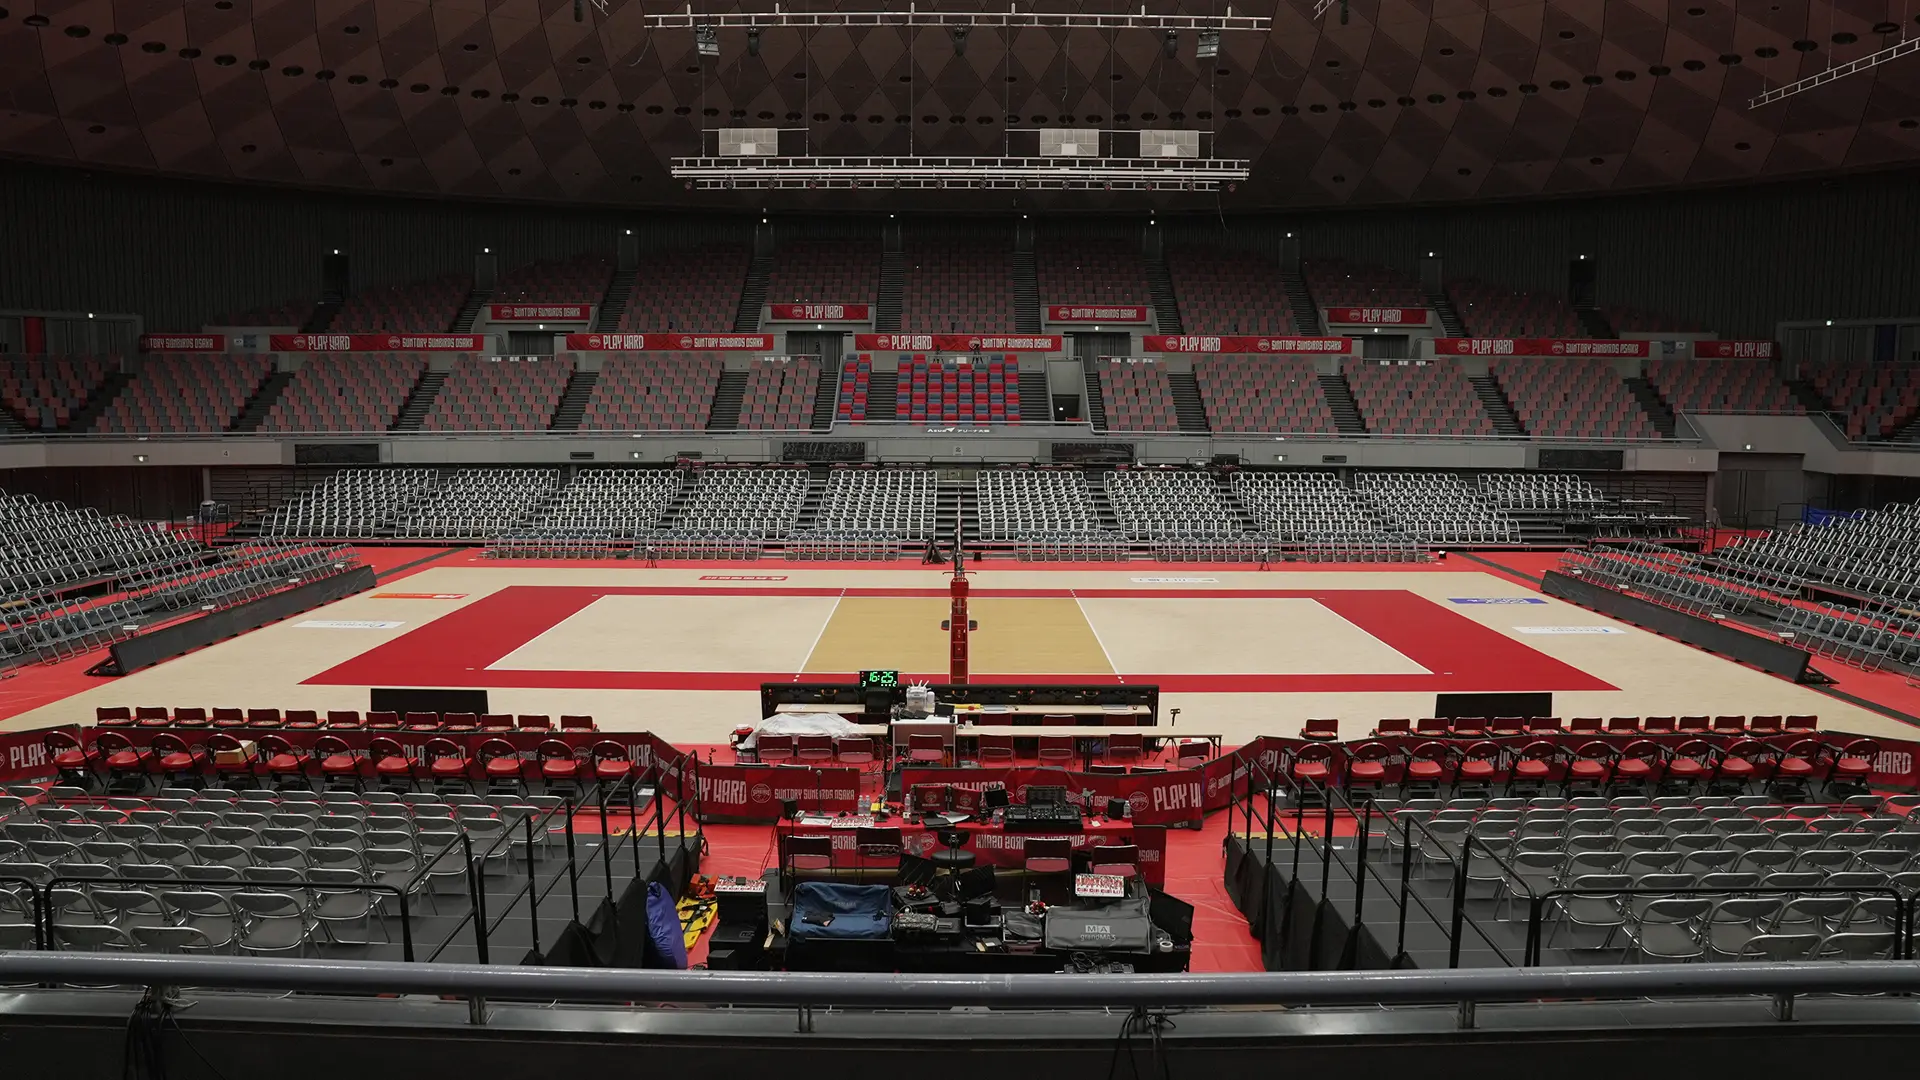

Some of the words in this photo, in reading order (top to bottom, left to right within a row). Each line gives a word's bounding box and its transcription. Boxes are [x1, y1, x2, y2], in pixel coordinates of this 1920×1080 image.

[514, 307, 537, 317] SUNTORY
[538, 307, 563, 317] SUNBIRDS
[563, 308, 580, 317] OSAKA
[805, 305, 824, 319] PLAY
[824, 305, 843, 318] HARD
[1071, 308, 1094, 318] SUNTORY
[1095, 308, 1119, 318] SUNBIRDS
[1120, 309, 1137, 318] OSAKA
[1362, 309, 1382, 322] PLAY
[1382, 309, 1401, 322] HARD
[308, 335, 328, 350] PLAY
[329, 336, 350, 350] HARD
[402, 337, 427, 348] SUNTORY
[428, 337, 454, 348] SUNBIRDS
[455, 338, 473, 348] OSAKA
[602, 334, 622, 350] PLAY
[623, 335, 644, 350] HARD
[694, 337, 719, 348] SUNTORY
[719, 337, 745, 348] SUNBIRDS
[746, 337, 764, 348] OSAKA
[891, 335, 911, 349] PLAY
[912, 335, 932, 349] HARD
[982, 338, 1006, 348] SUNTORY
[1007, 338, 1033, 348] SUNBIRDS
[1034, 338, 1051, 348] OSAKA
[1179, 337, 1200, 352] PLAY
[1200, 337, 1220, 352] HARD
[1271, 339, 1296, 350] SUNTORY
[1296, 340, 1323, 350] SUNBIRDS
[1323, 340, 1342, 350] OSAKA
[1471, 339, 1492, 354] PLAY
[1492, 340, 1514, 354] HARD
[1565, 342, 1591, 353] SUNTORY
[1591, 343, 1619, 354] SUNBIRDS
[1620, 343, 1639, 354] OSAKA
[1734, 342, 1755, 357] PLAY
[870, 672, 894, 682] 16:25
[10, 742, 47, 770] PLAY
[1872, 751, 1912, 774] HARD
[714, 780, 747, 804] HARD
[774, 788, 802, 800] SUNTORY
[834, 790, 855, 800] OSAKA
[1152, 784, 1188, 811] PLAY
